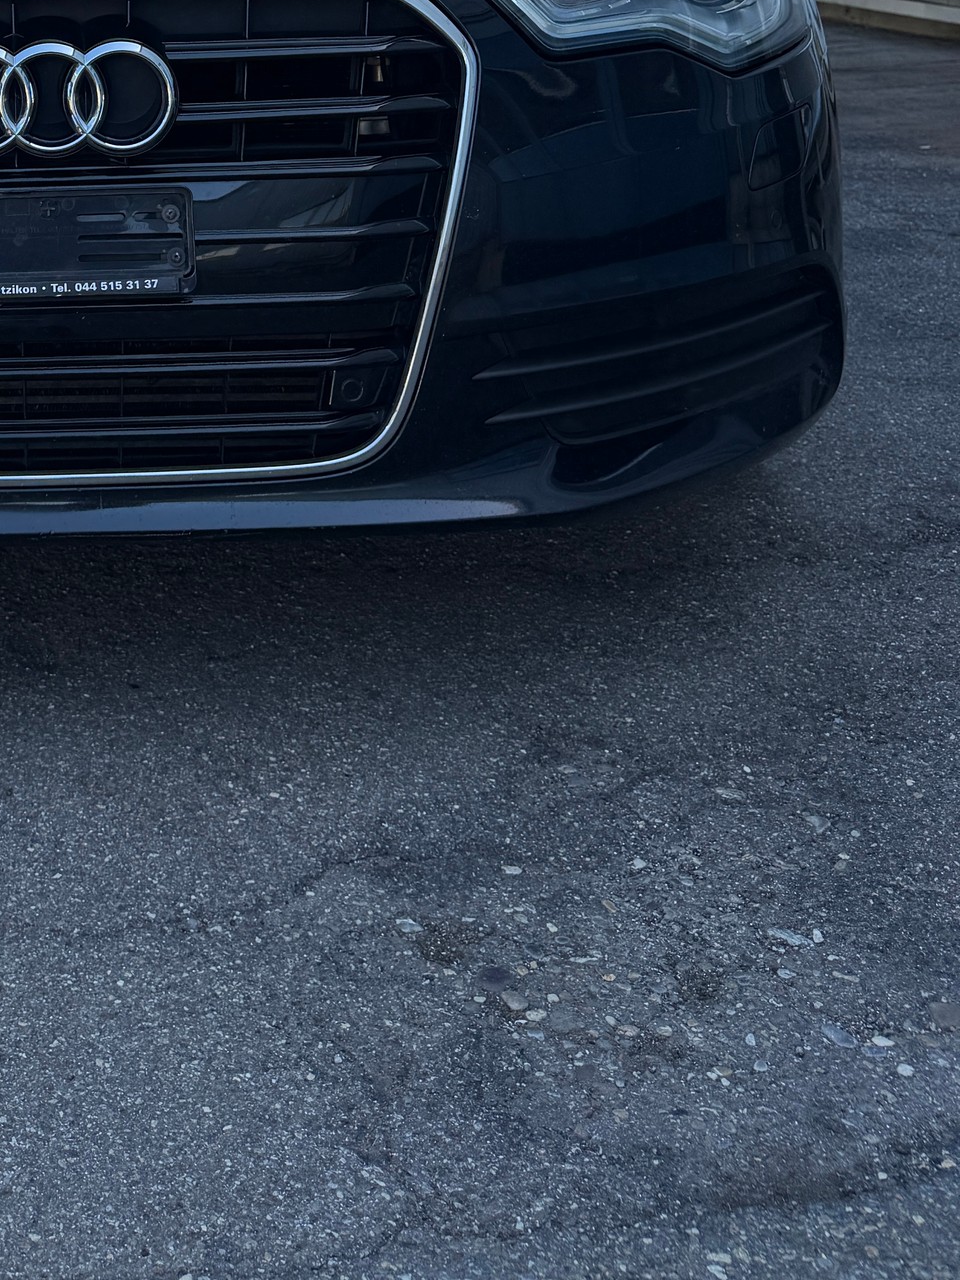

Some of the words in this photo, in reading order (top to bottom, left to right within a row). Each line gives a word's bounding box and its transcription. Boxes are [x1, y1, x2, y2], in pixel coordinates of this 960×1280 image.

[50, 282, 72, 293] Tel.
[74, 281, 98, 292] 044
[100, 280, 123, 291] 515
[125, 280, 141, 290] 31
[144, 279, 159, 289] 37
